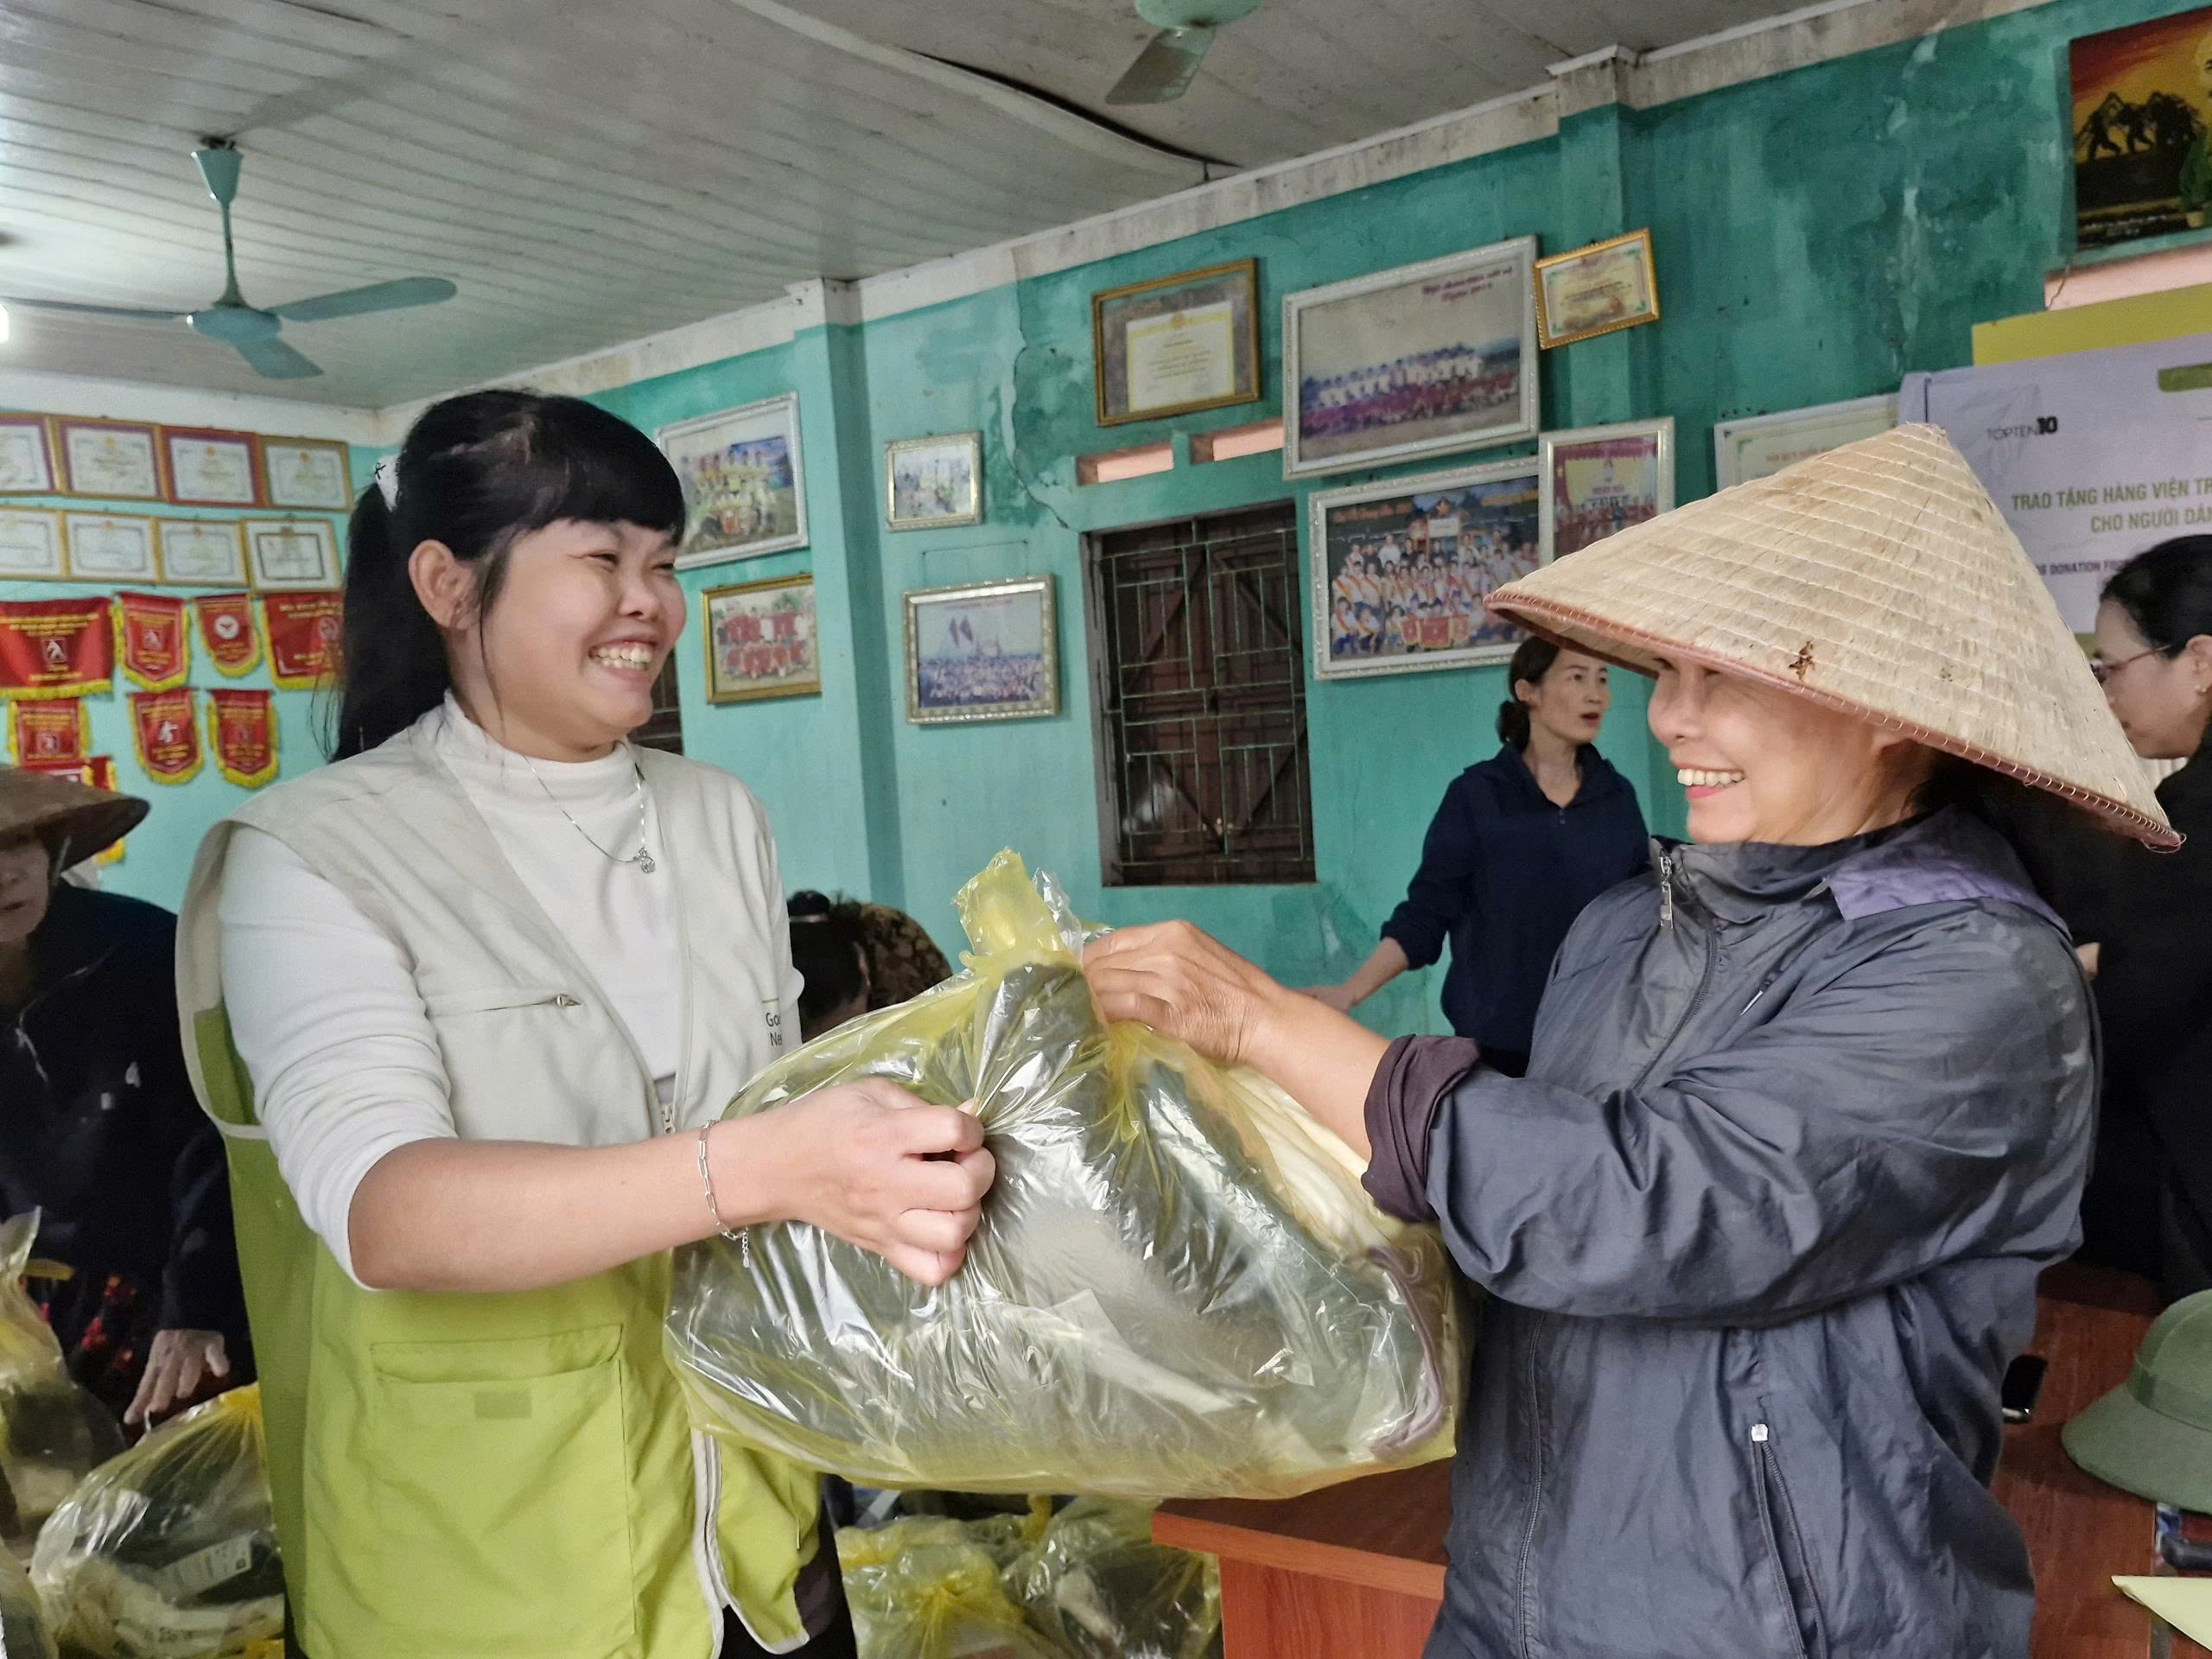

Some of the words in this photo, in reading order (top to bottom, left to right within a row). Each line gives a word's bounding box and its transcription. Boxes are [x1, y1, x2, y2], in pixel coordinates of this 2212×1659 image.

[2012, 493, 2051, 511] TRAO
[2103, 481, 2147, 504] HÀNG
[2090, 514, 2123, 533] CHO
